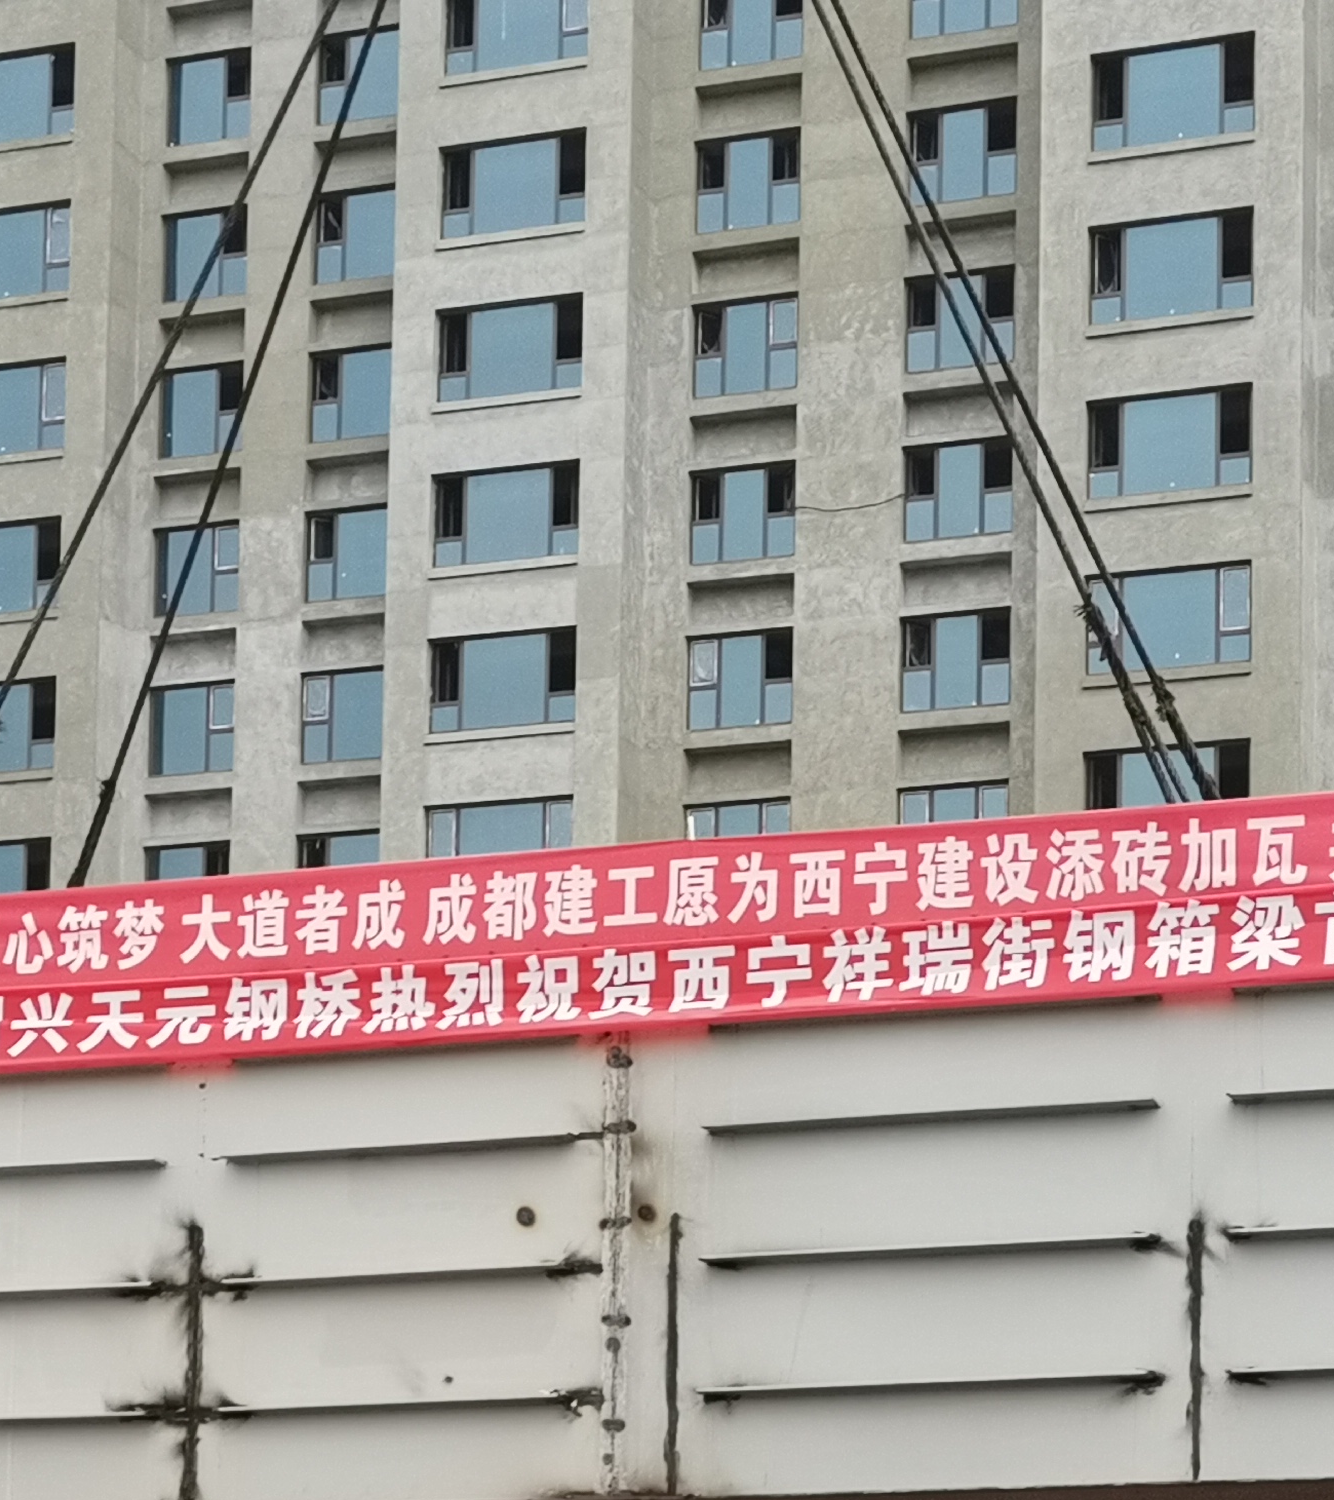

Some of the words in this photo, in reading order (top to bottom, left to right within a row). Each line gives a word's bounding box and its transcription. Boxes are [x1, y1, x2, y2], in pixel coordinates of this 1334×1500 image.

[179, 879, 406, 964] 大道者成
[422, 814, 1308, 945] 成都建工愿为西宁建设添砖加瓦
